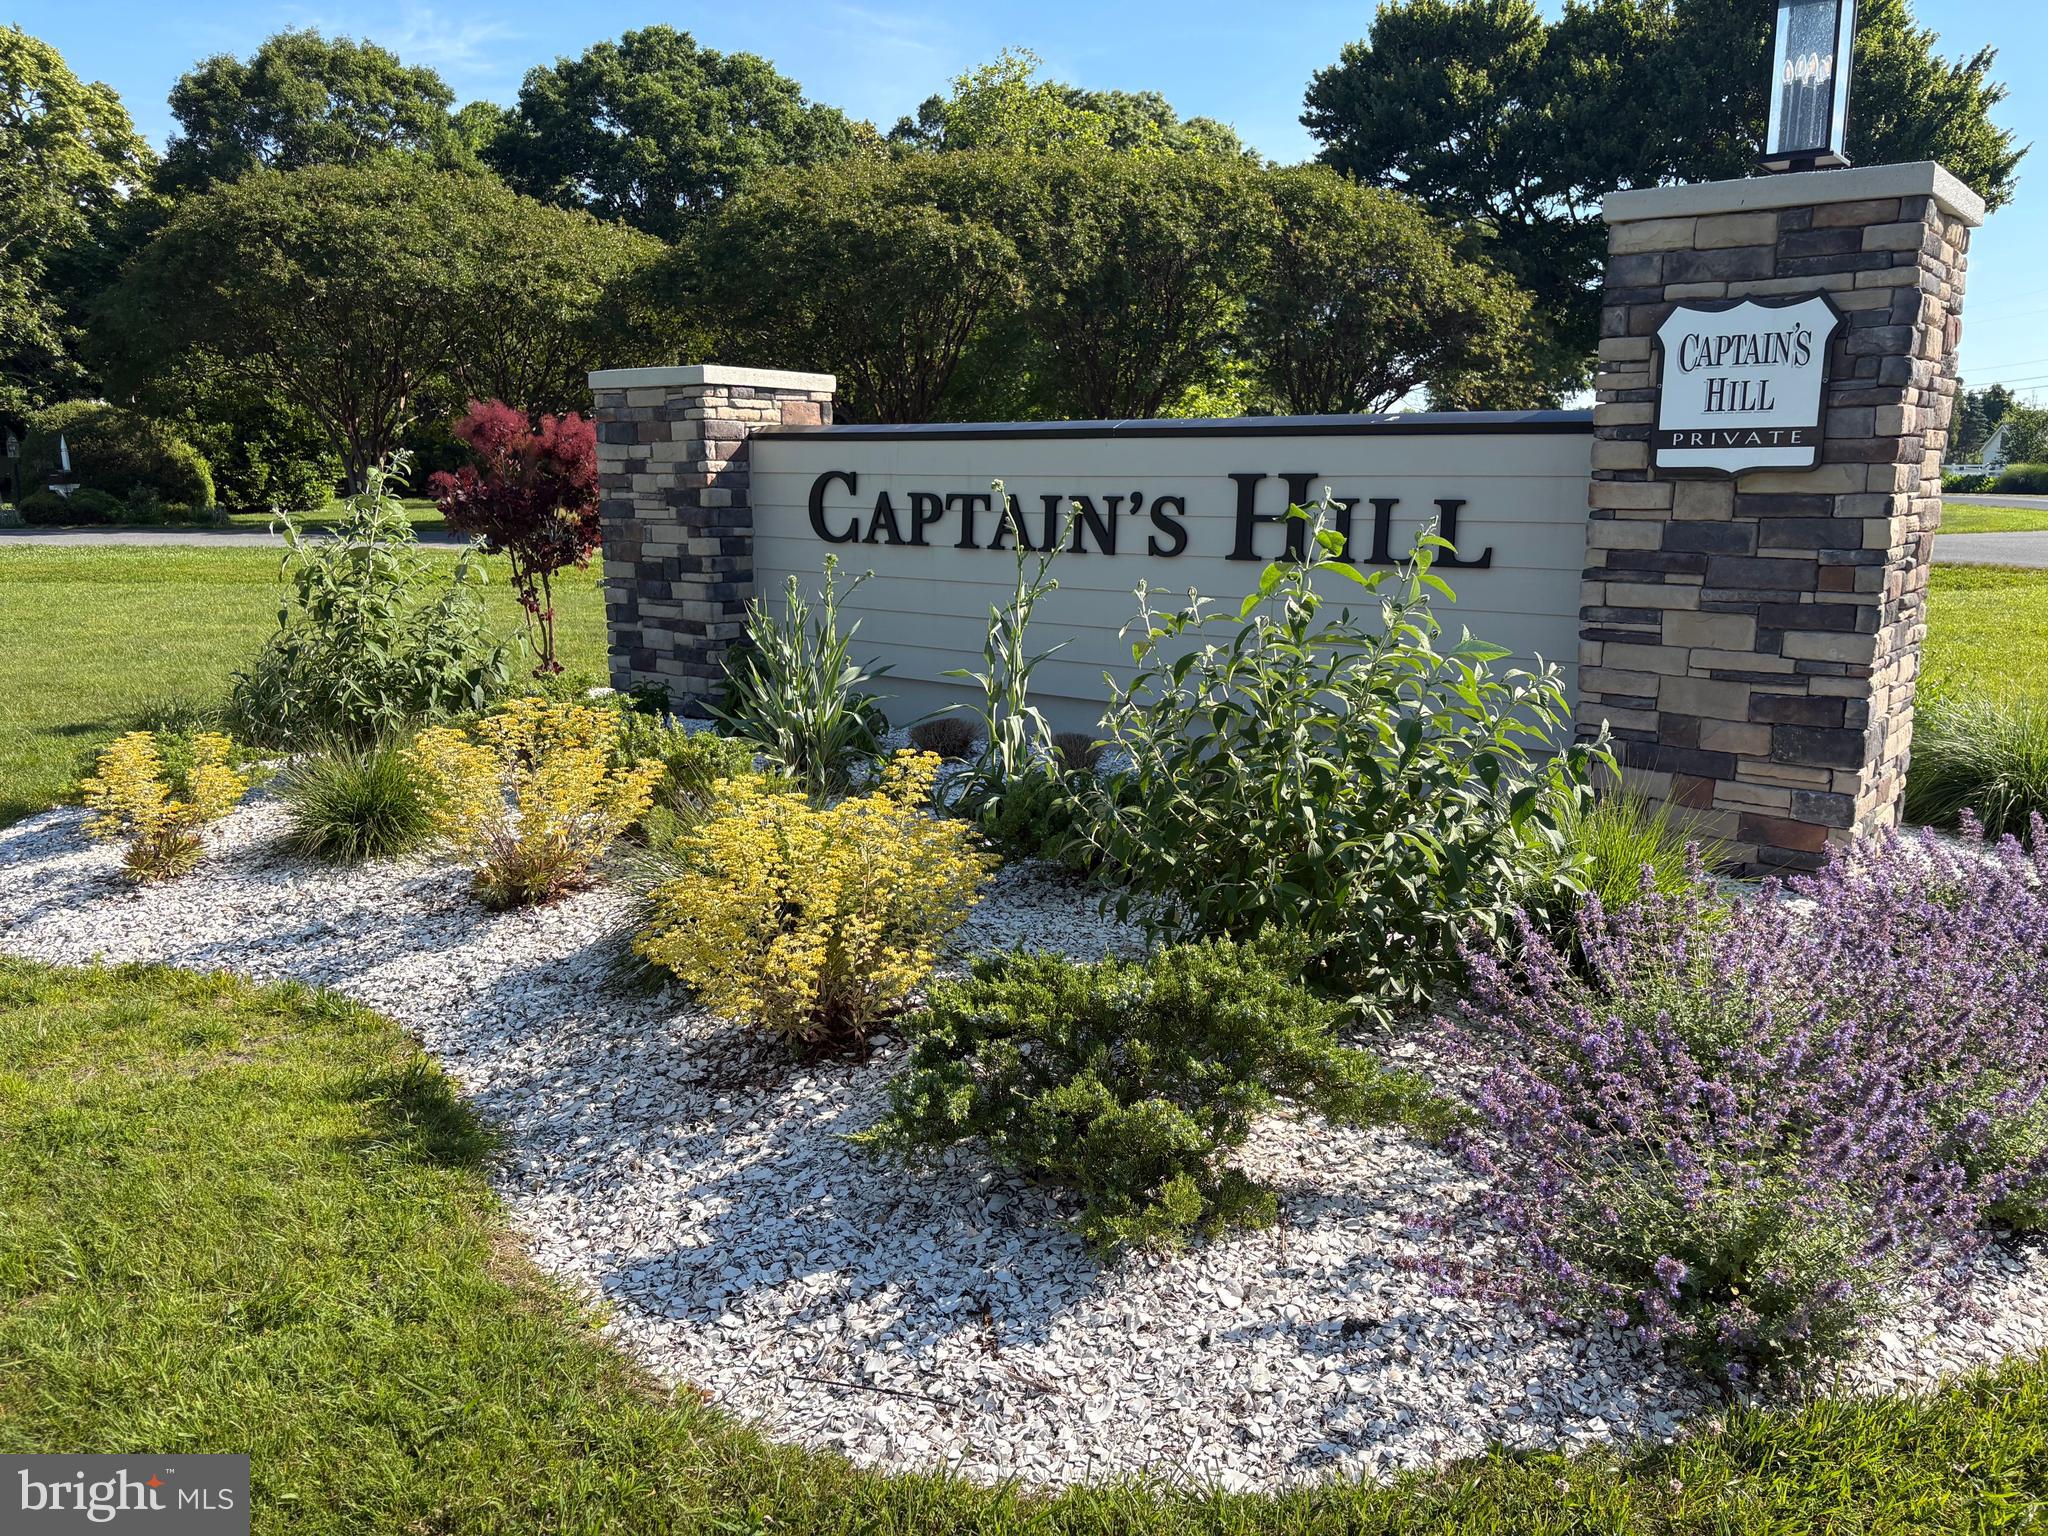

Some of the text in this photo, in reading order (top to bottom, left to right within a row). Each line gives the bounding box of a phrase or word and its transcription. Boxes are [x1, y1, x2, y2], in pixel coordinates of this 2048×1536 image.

[1679, 321, 1812, 373] CAPTAIN'S
[1702, 377, 1775, 413] HILL
[1672, 430, 1802, 446] PRIVATE
[808, 471, 1493, 569] CAPTAIN'S HILL
